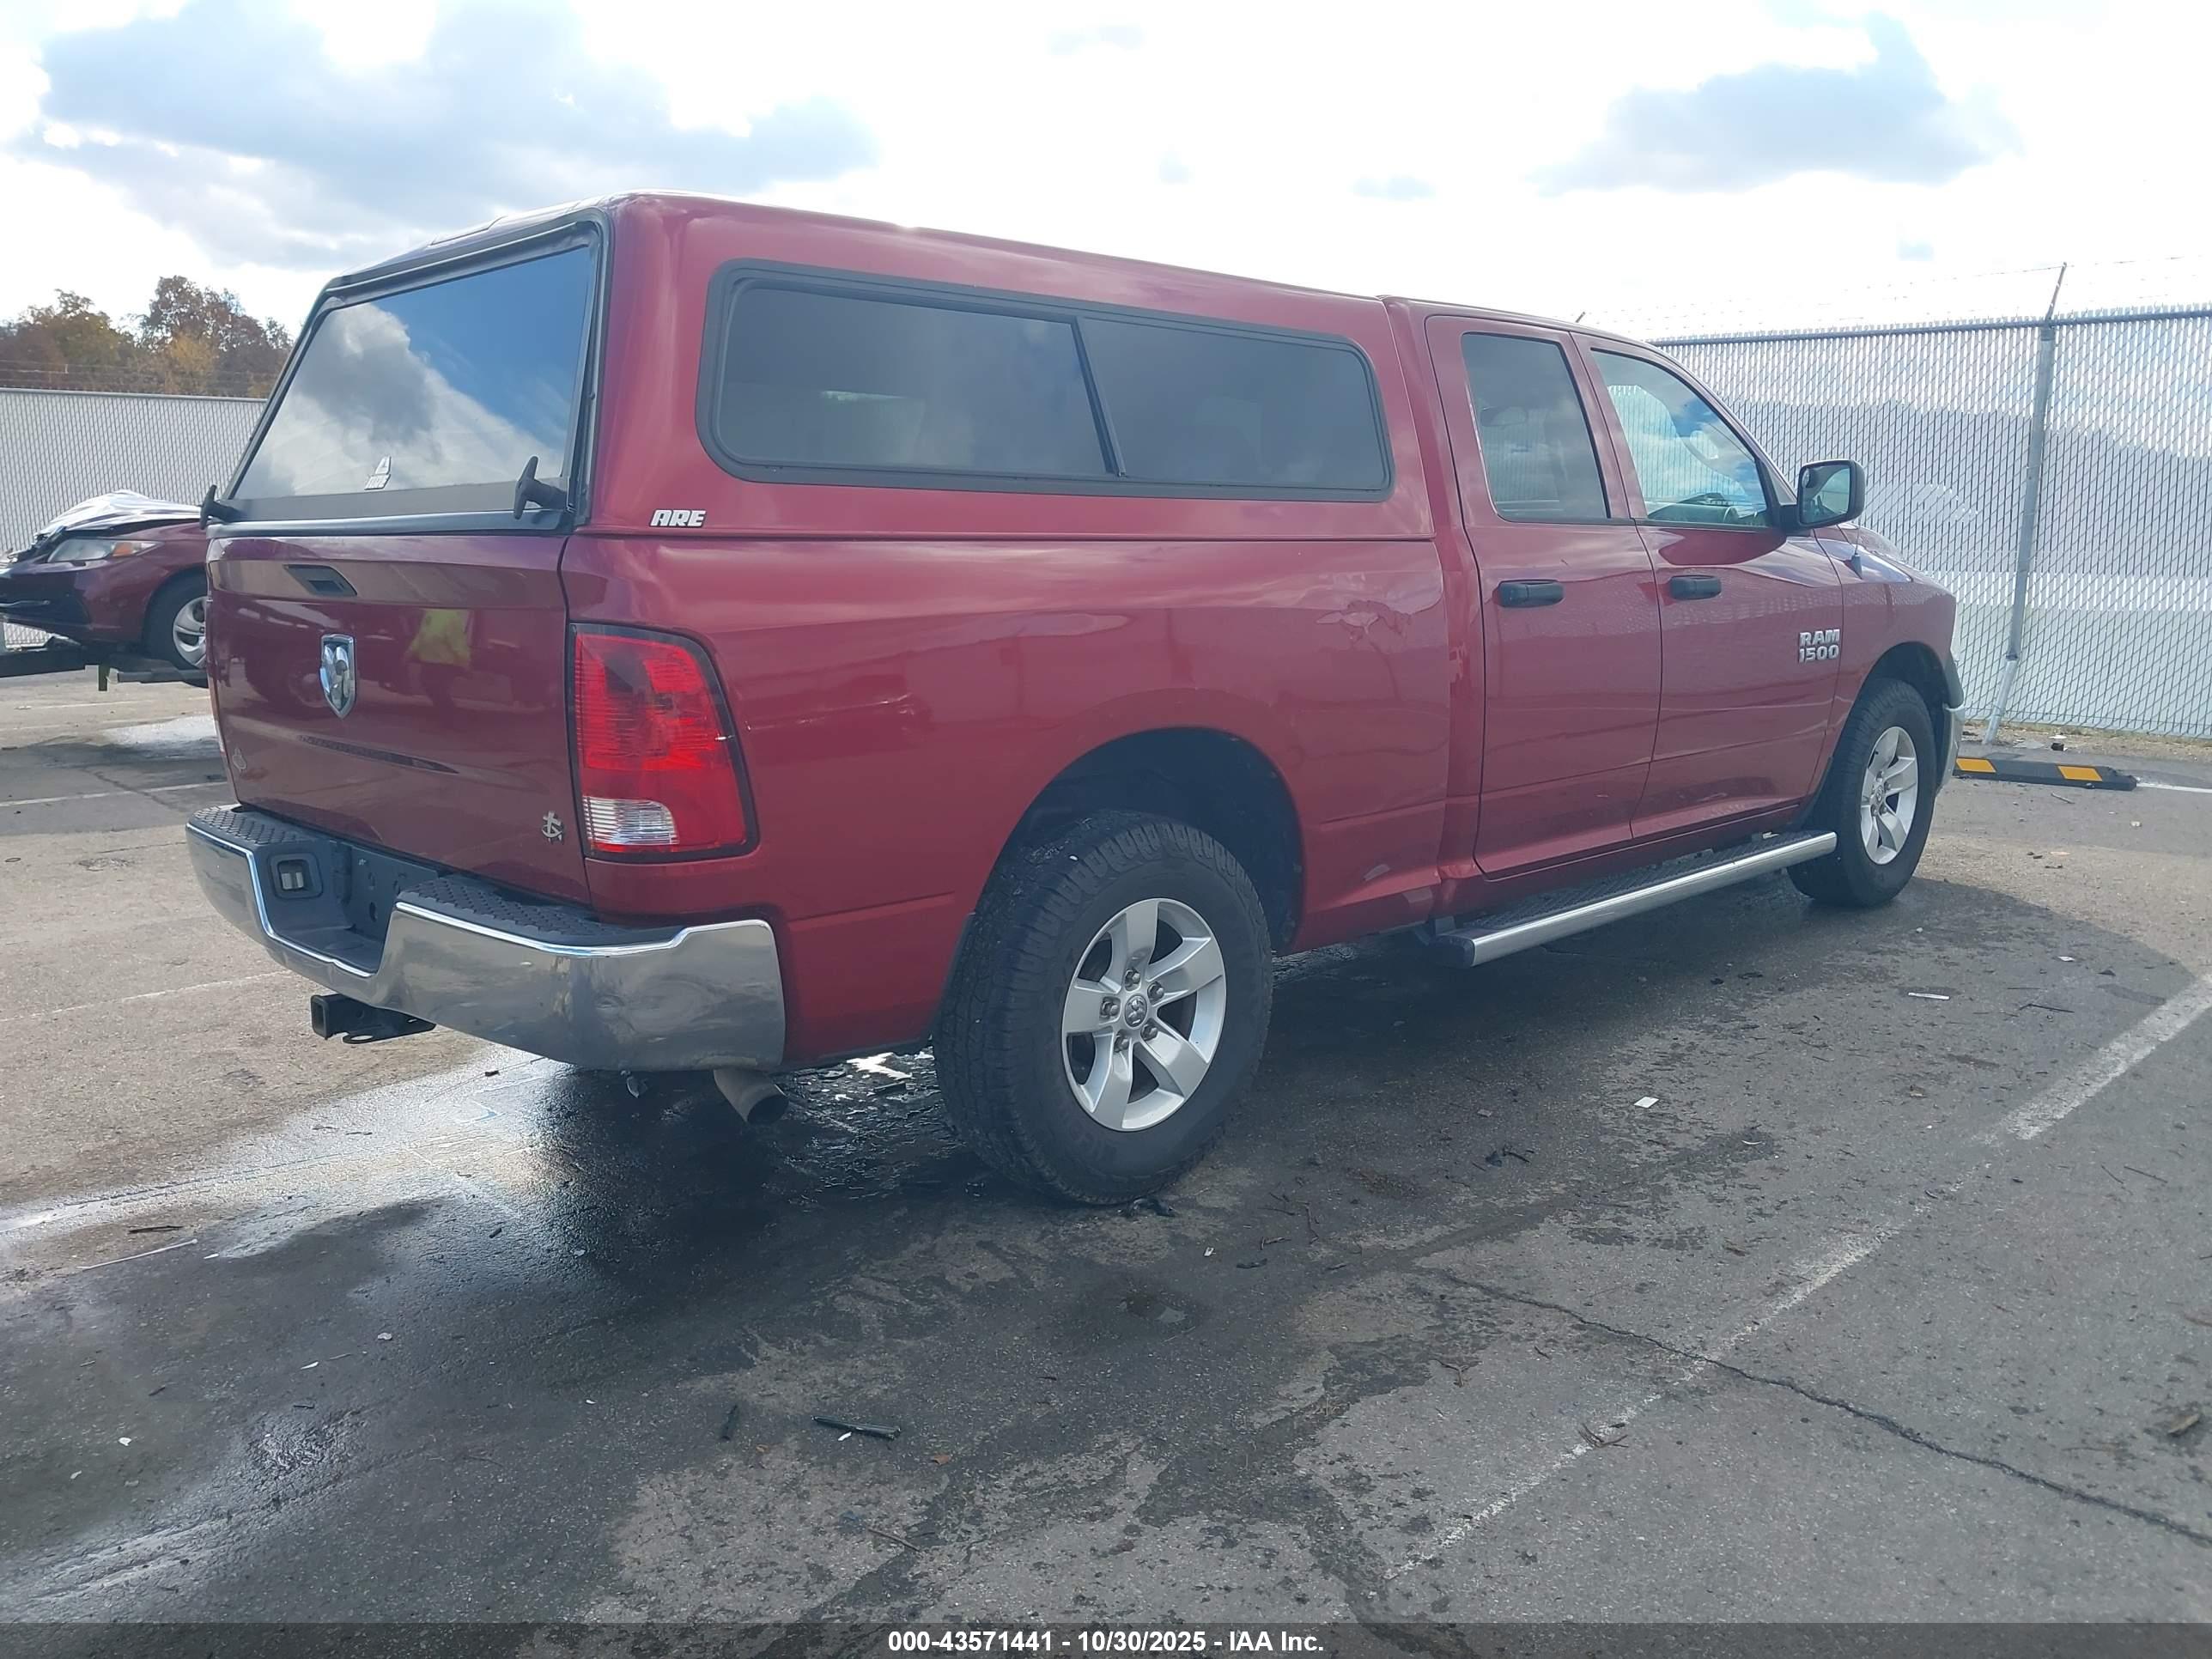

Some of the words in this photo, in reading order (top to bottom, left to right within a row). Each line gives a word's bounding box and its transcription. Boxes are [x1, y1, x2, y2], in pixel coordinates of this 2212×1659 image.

[650, 509, 707, 527] ARE
[1799, 629, 1840, 647] RAM
[1799, 644, 1839, 663] 1500
